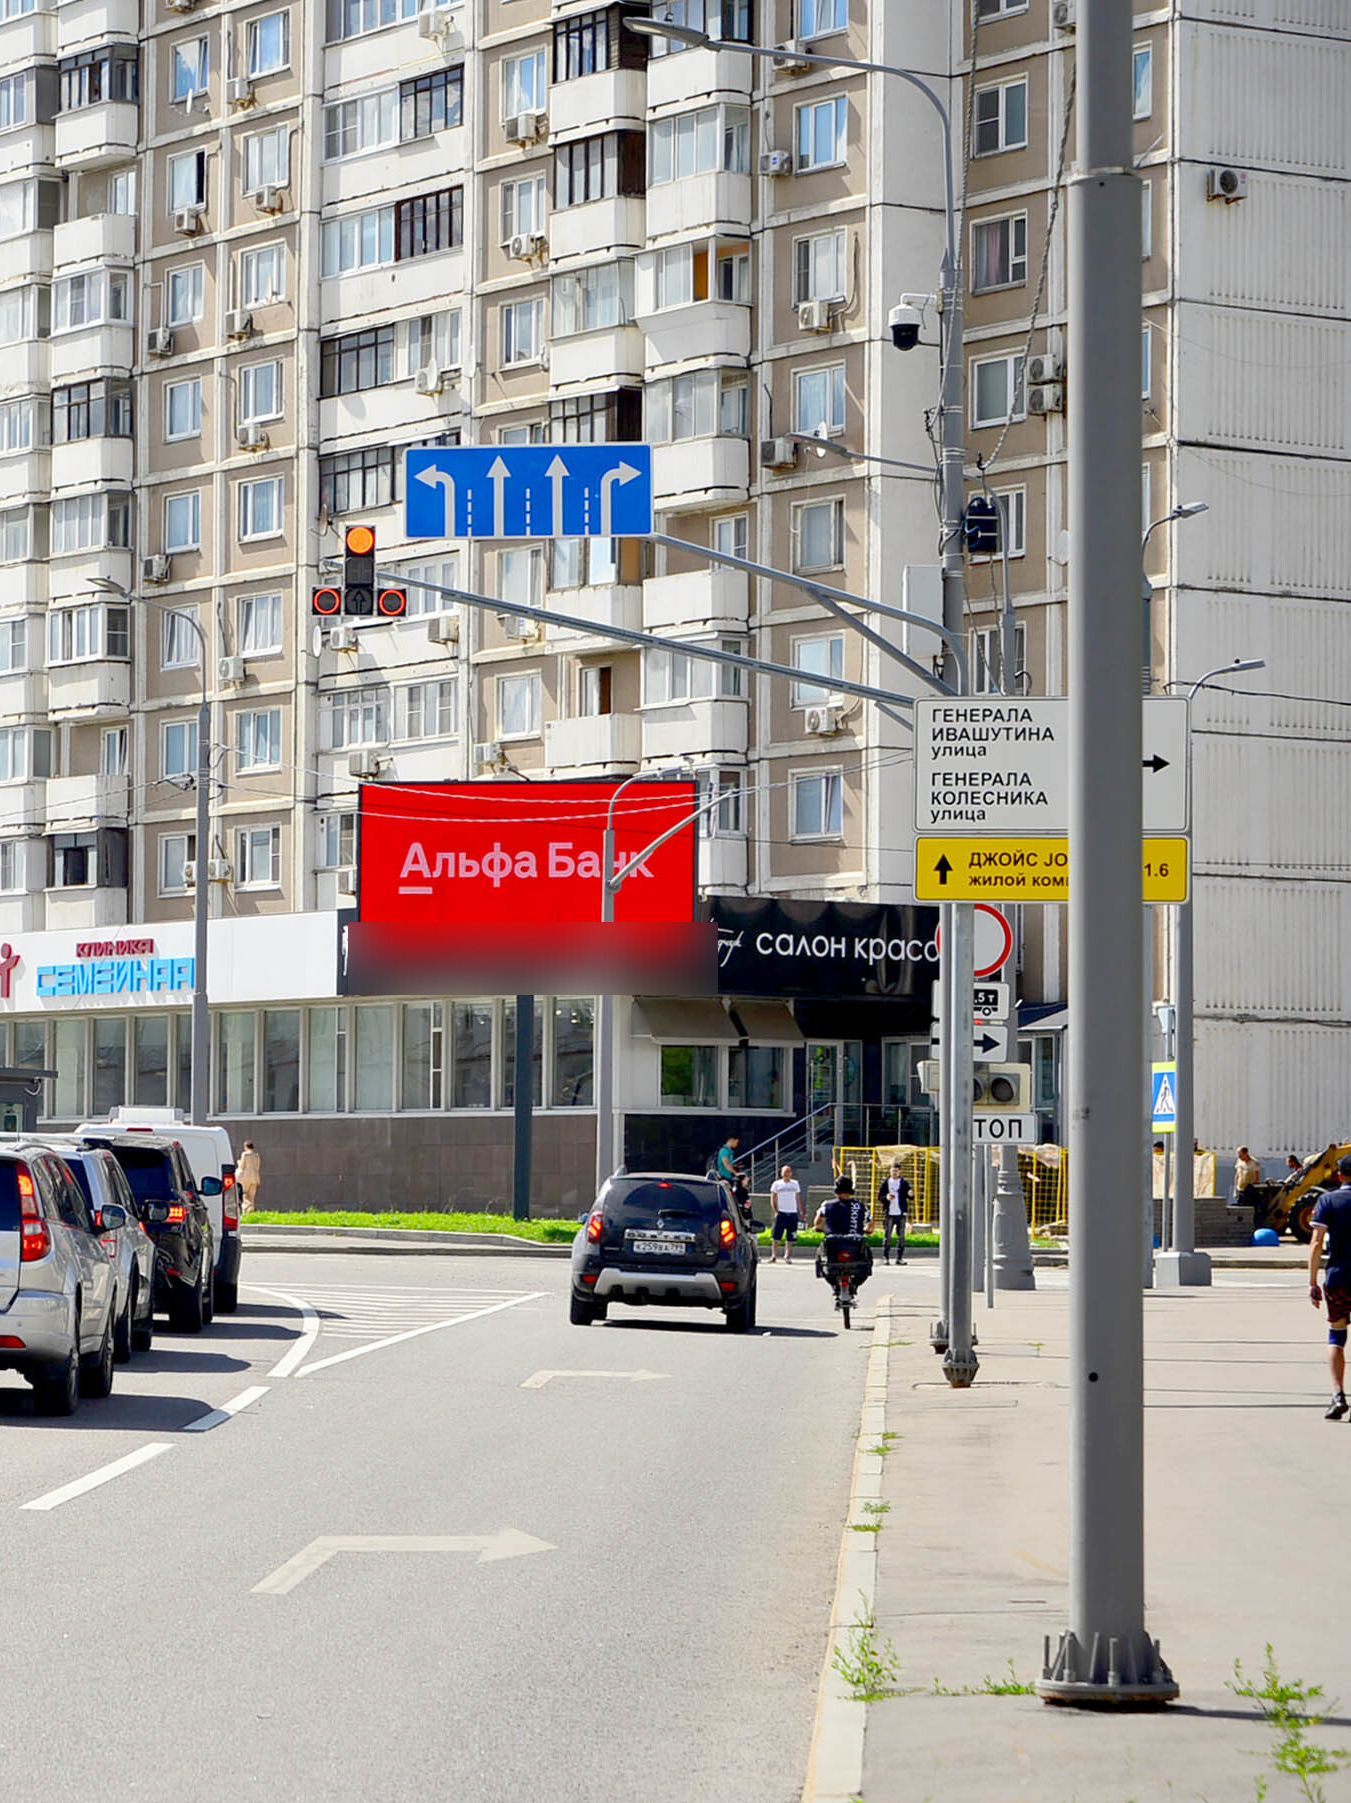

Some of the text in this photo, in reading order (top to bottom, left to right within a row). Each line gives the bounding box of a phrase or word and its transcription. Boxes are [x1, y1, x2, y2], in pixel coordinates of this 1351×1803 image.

[932, 708, 1033, 723] ГЕНЕРАЛА
[932, 727, 1054, 742] ИВАШУТИНА
[931, 745, 987, 760] улица
[931, 772, 1032, 787] ГЕНЕРАЛА
[931, 791, 1048, 806] КОЛЕСНИКА
[931, 808, 986, 824] улица
[399, 842, 538, 888] Альфа
[968, 849, 1068, 869] ДЖОЙС JO
[1144, 863, 1169, 877] 1.6
[968, 872, 1068, 887] жилой ком
[76, 938, 154, 958] КЛИНИКА
[756, 932, 846, 958] салон
[854, 937, 940, 966] красо
[973, 1119, 1022, 1138] ТОП
